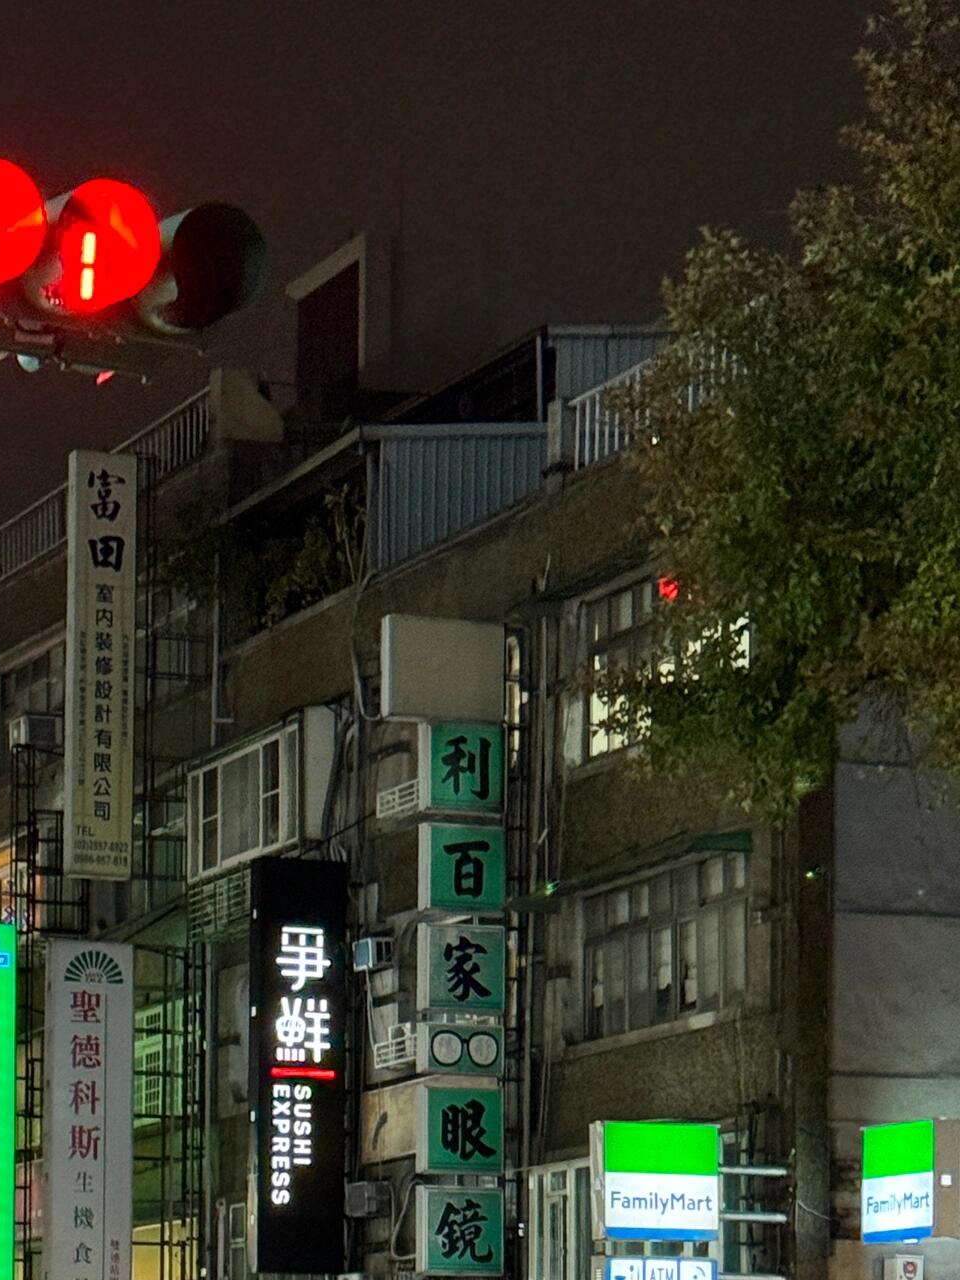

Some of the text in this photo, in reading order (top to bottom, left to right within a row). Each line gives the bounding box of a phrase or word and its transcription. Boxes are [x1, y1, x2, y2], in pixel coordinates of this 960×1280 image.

[87, 468, 126, 573] 富田
[93, 584, 116, 822] 室內裝修設計有限公司
[69, 989, 101, 1160] 聖德科斯
[293, 1083, 312, 1166] SUSHI
[271, 1083, 291, 1206] EXPRESS
[610, 1191, 713, 1213] FamilyMart
[866, 1191, 930, 1214] FamilyMart
